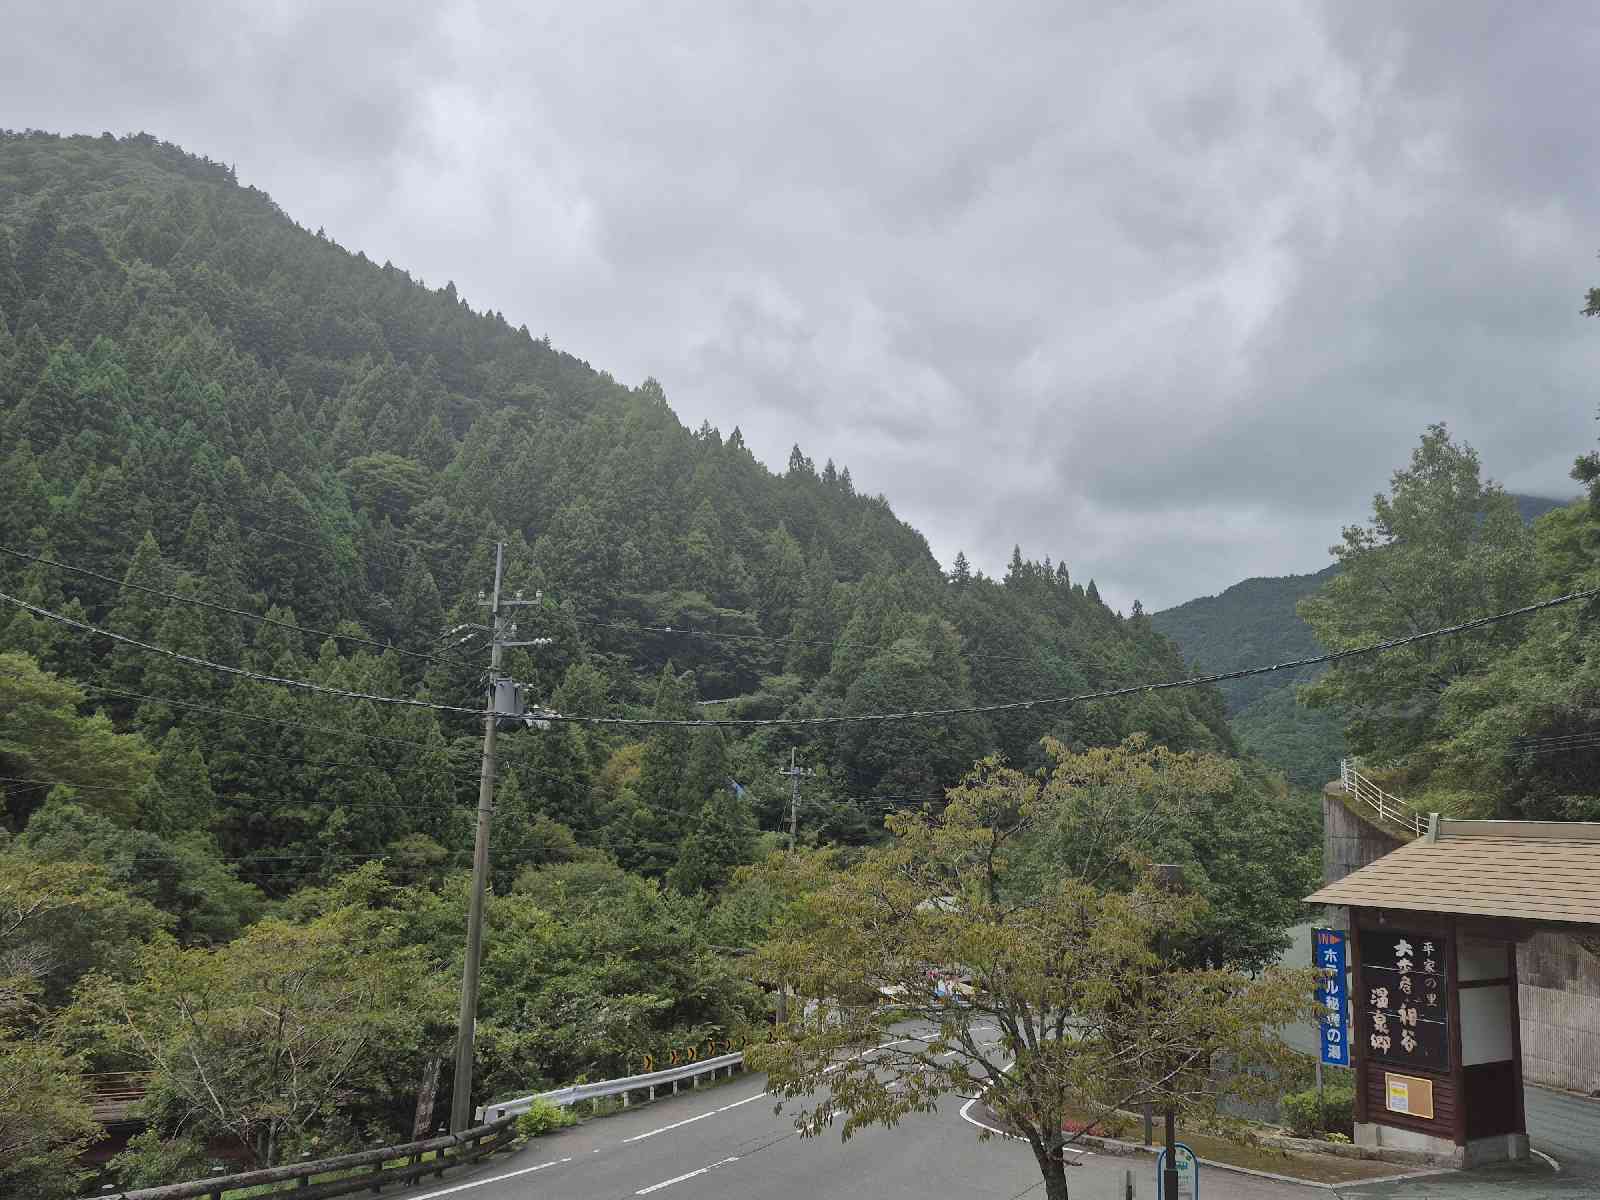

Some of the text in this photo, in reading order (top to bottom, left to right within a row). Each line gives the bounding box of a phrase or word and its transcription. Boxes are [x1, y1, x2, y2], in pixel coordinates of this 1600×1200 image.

[1422, 941, 1437, 1007] 平家の里
[1370, 986, 1392, 1055] 温泉郷
